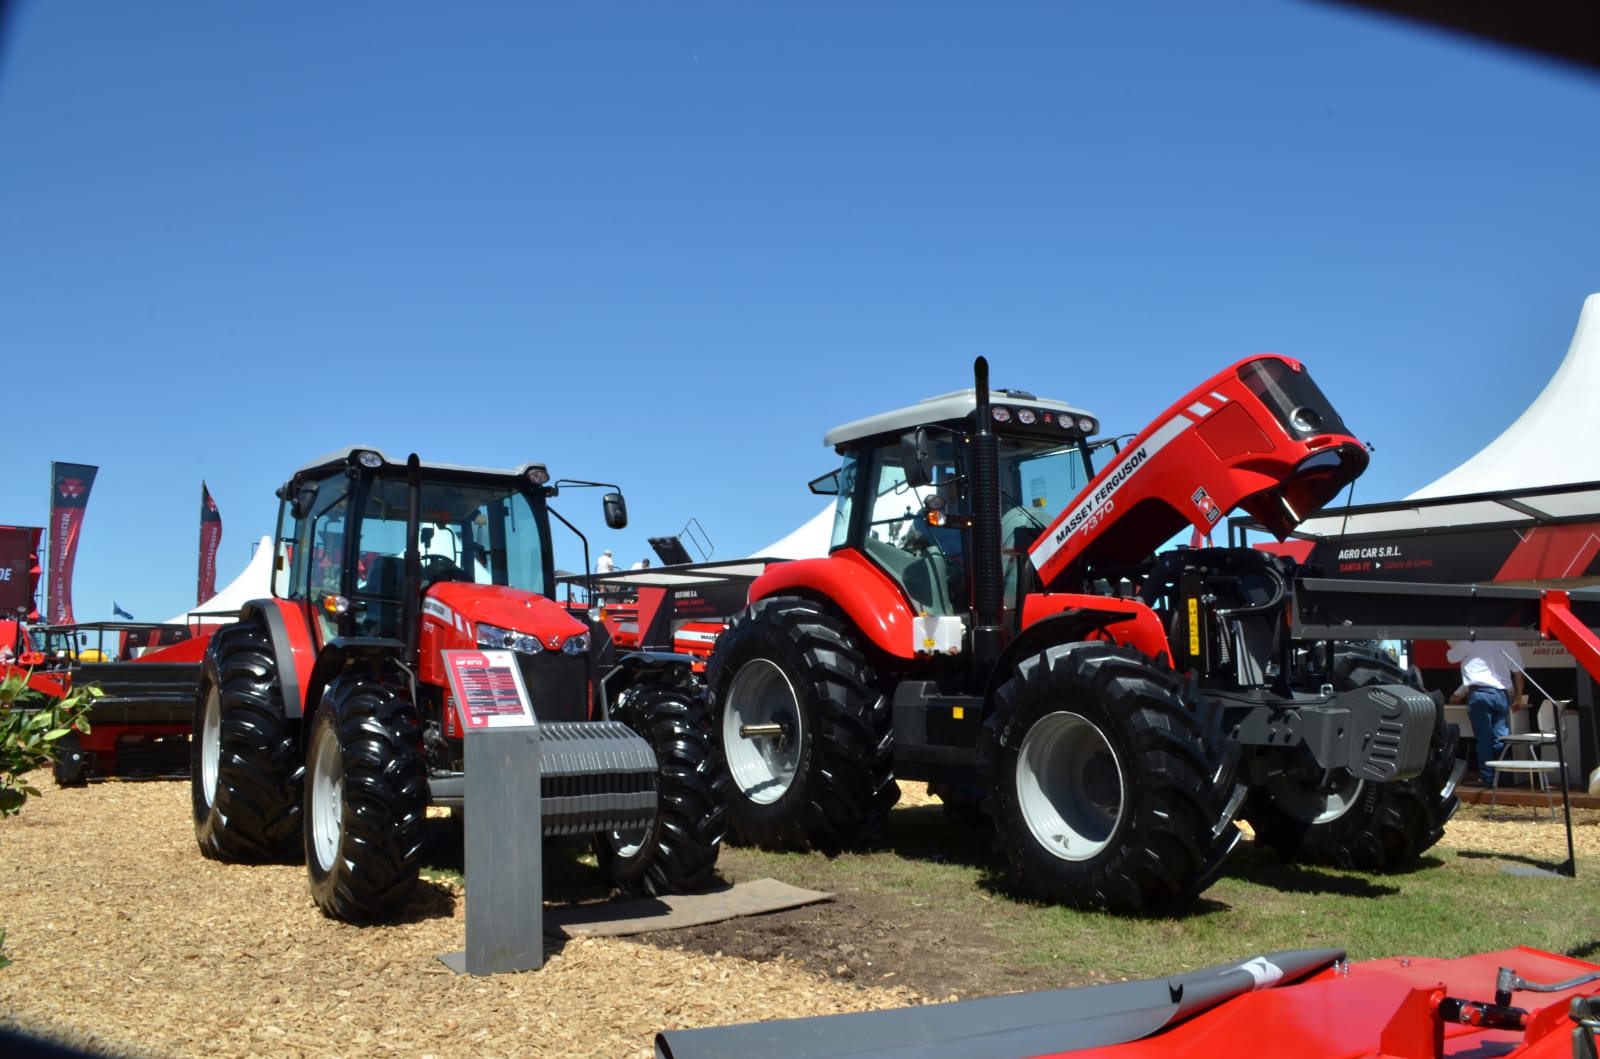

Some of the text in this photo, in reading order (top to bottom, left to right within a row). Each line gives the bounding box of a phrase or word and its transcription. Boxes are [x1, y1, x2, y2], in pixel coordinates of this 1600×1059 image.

[1056, 448, 1147, 544] MASSEY FERGUSON
[1080, 500, 1115, 536] 7370
[1338, 546, 1401, 560] AGRO CAR S.R.L.
[1340, 563, 1361, 572] SANTA
[1362, 562, 1371, 570] FE
